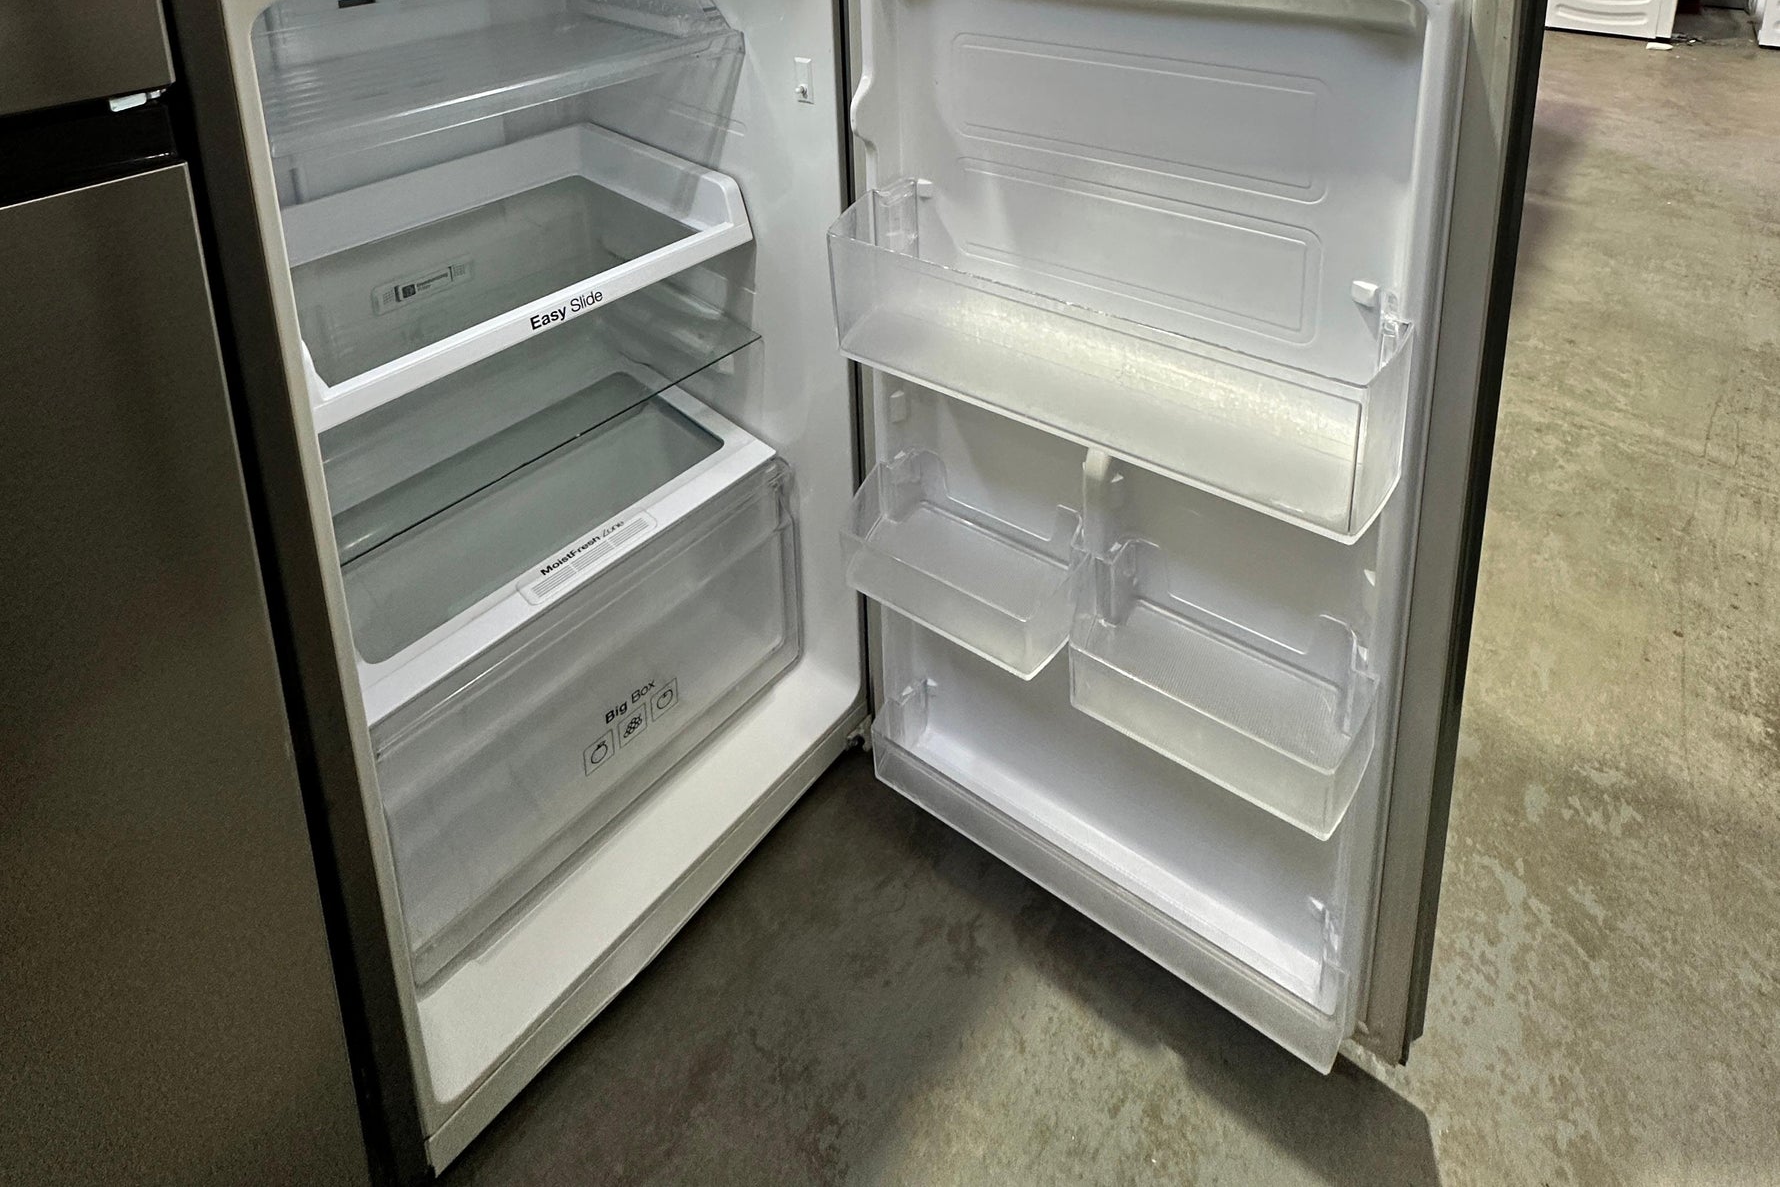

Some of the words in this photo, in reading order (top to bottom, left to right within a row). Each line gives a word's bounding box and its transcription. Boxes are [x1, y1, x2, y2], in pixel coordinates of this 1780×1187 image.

[530, 306, 567, 330] Easy
[570, 291, 603, 312] Slide
[540, 535, 601, 576] MoistFresh
[605, 701, 628, 724] Big
[631, 680, 655, 703] Box
